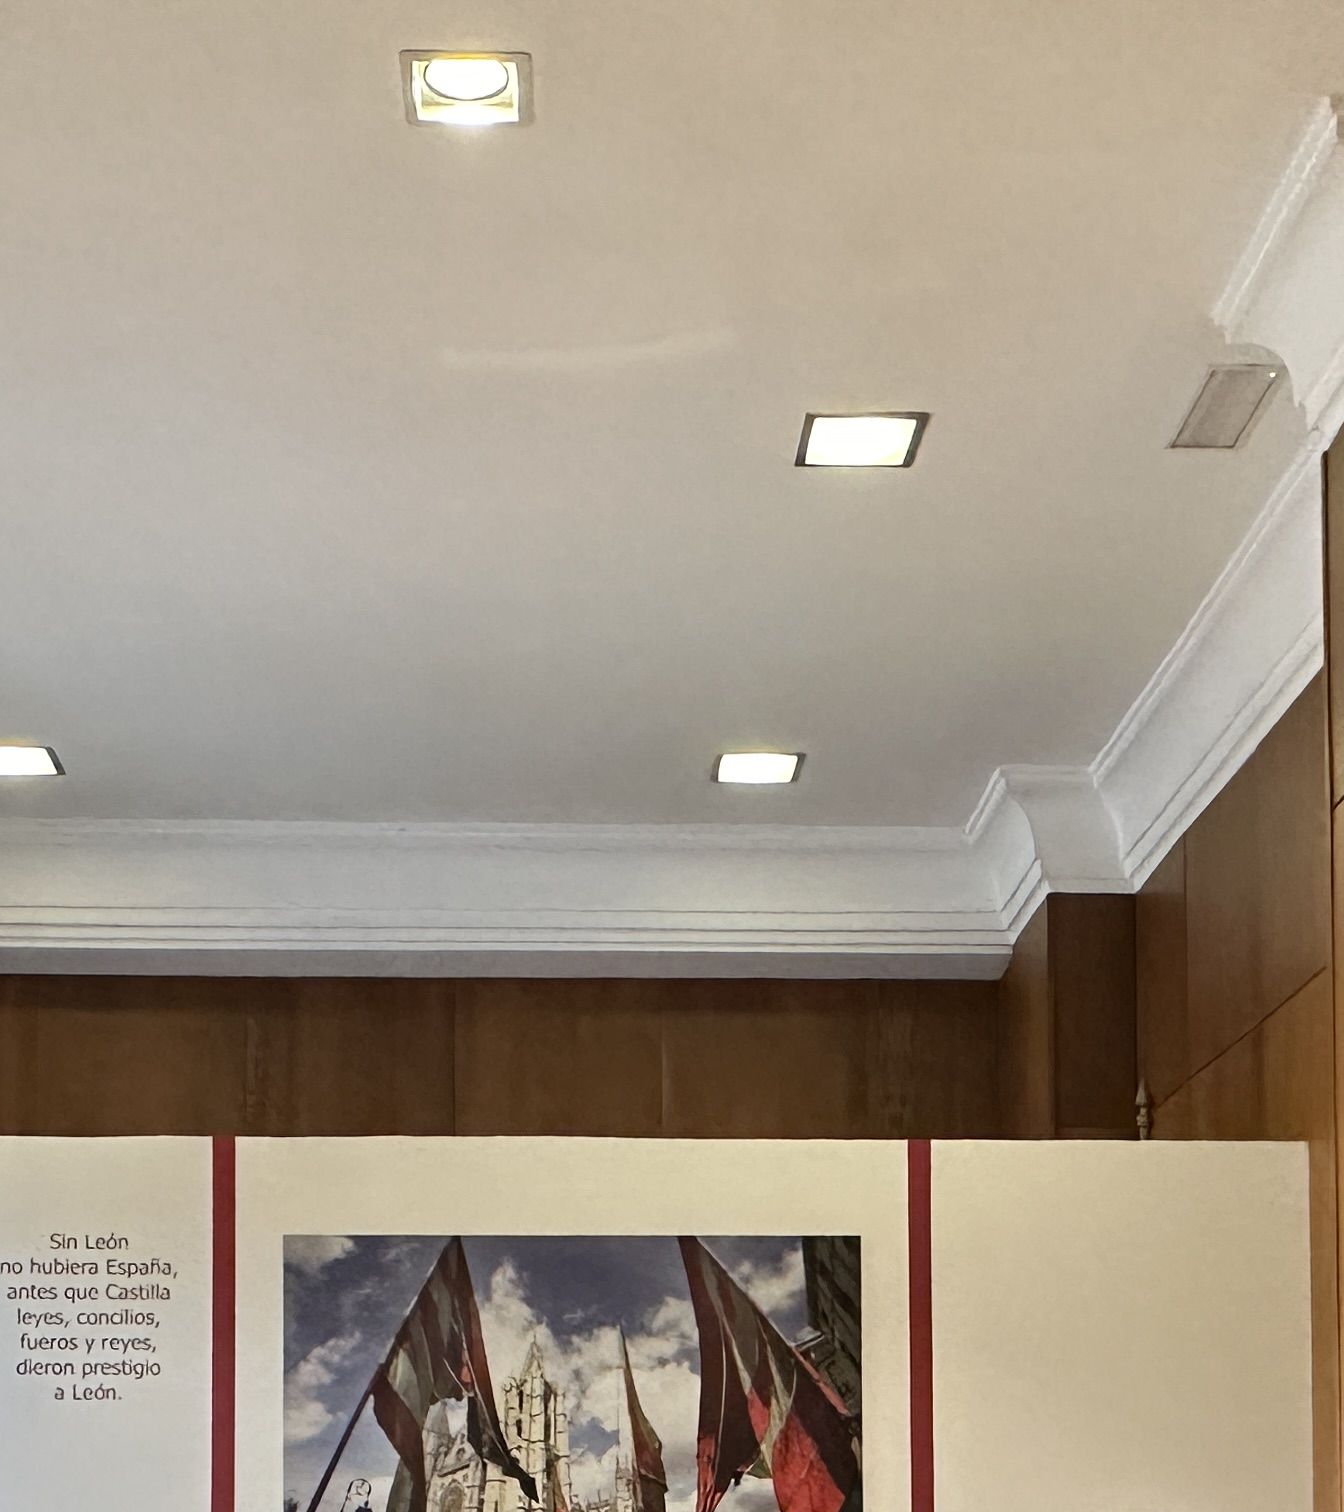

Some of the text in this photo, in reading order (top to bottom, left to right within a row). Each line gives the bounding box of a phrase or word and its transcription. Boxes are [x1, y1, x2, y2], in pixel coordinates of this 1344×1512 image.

[49, 1231, 129, 1250] Sin León
[0, 1257, 178, 1279] no hubiera España,
[6, 1283, 171, 1304] antes que Castilla
[17, 1307, 161, 1329] leyes, concilios,
[20, 1332, 157, 1355] fueros y reyes,
[15, 1358, 161, 1380] dieron prestigio
[54, 1383, 123, 1401] a León.
